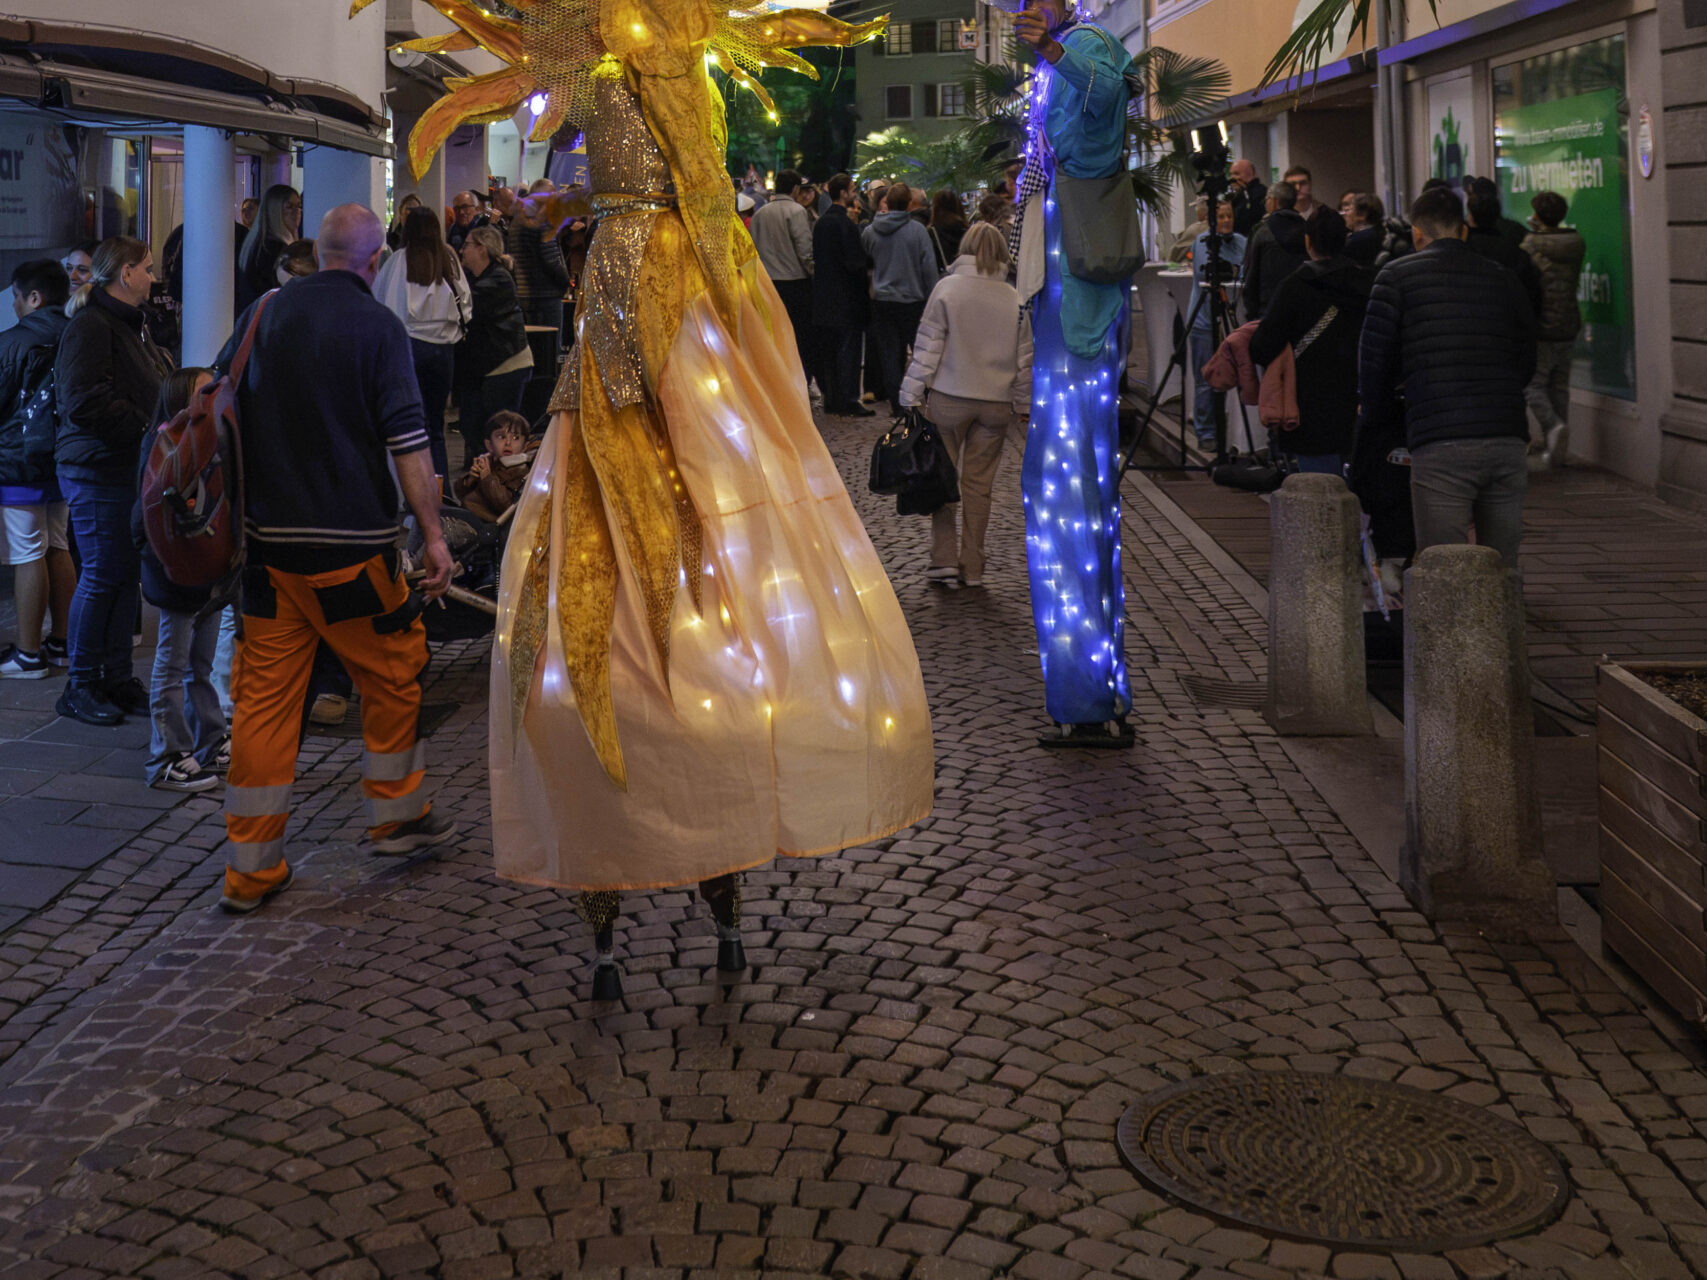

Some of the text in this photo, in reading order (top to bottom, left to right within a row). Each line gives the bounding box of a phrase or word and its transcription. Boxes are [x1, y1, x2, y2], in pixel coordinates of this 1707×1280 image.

[964, 34, 974, 42] M
[1511, 151, 1604, 193] zu vermieten
